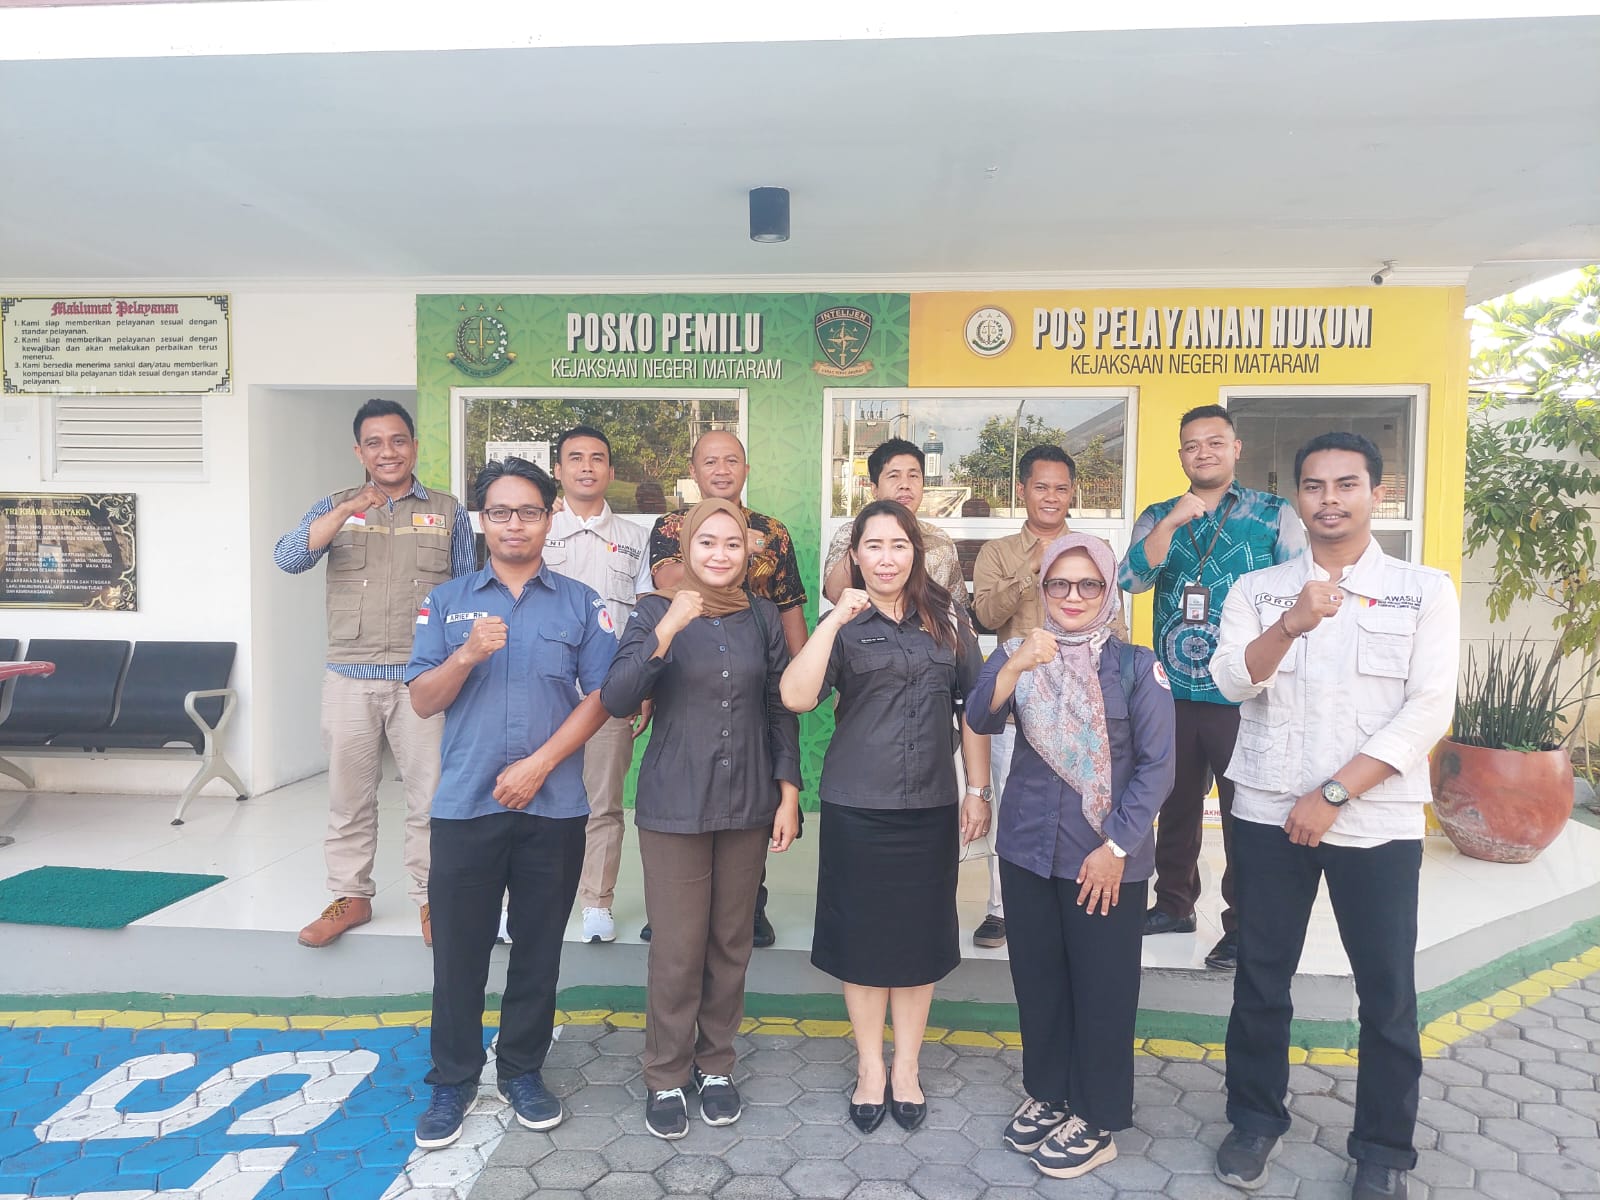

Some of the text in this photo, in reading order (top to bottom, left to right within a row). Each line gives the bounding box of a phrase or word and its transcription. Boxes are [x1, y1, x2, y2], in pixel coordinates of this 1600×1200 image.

[51, 300, 179, 317] Maklumat Pelayanan
[820, 308, 867, 321] INTELIJEN
[45, 319, 60, 328] siap
[116, 319, 155, 327] pelayanan
[189, 318, 218, 326] dengan
[1032, 304, 1373, 350] POS PELAYANAN HUKUM
[49, 328, 88, 337] pelayanan.
[567, 312, 763, 353] POSKO PEMILU
[46, 336, 60, 344] siap
[116, 336, 155, 344] pelayanan
[189, 335, 218, 344] dengan
[22, 345, 60, 353] kewajiban
[155, 344, 193, 352] perbaikan
[551, 358, 783, 379] KEJAKSAAN NEGERI MATARAM
[1070, 352, 1320, 375] KEJAKSAAN NEGERI MATARAM
[80, 370, 117, 378] pelayanan
[162, 369, 190, 378] dengan
